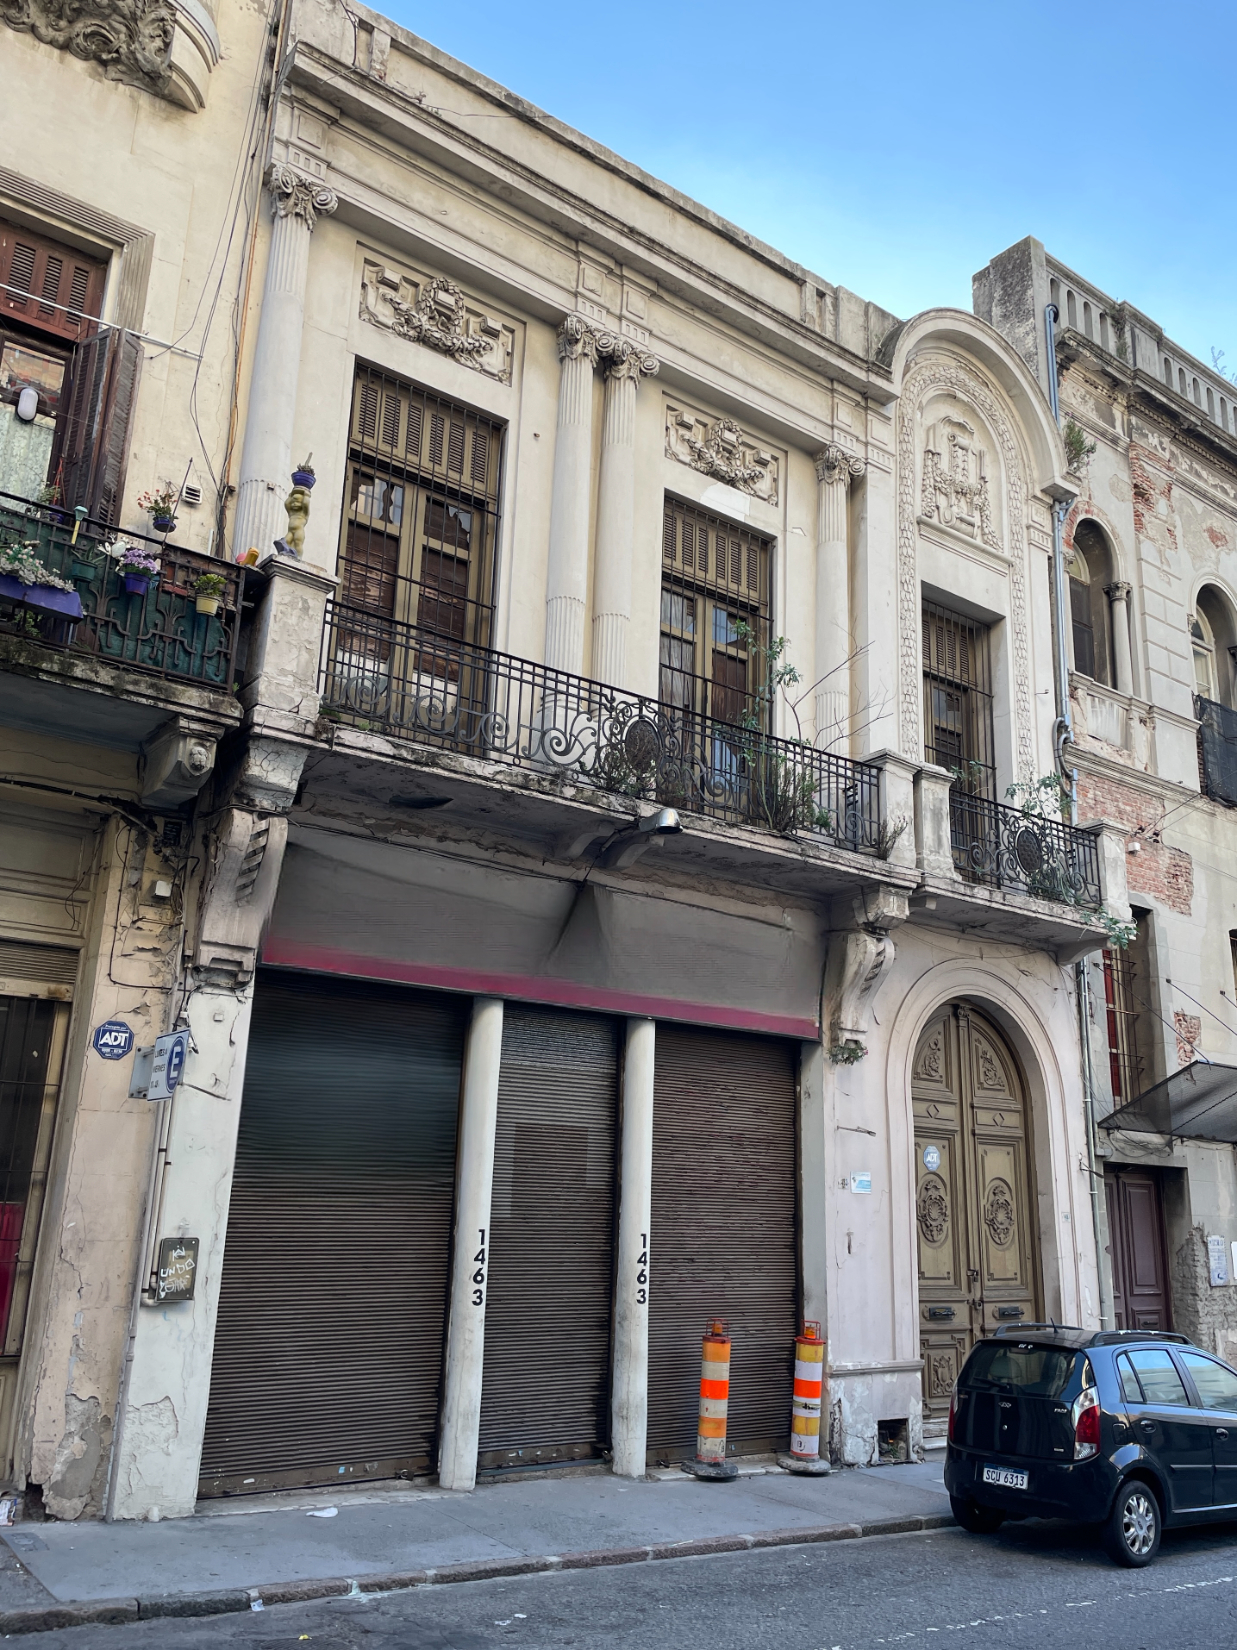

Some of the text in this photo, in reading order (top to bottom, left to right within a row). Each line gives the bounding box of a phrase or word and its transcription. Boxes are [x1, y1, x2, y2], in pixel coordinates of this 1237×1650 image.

[100, 1031, 129, 1046] ADT
[170, 1046, 181, 1078] E
[926, 1153, 937, 1162] ADT
[472, 1229, 486, 1306] 1463
[636, 1233, 647, 1304] 1463
[985, 1469, 1025, 1487] SCU 6313
